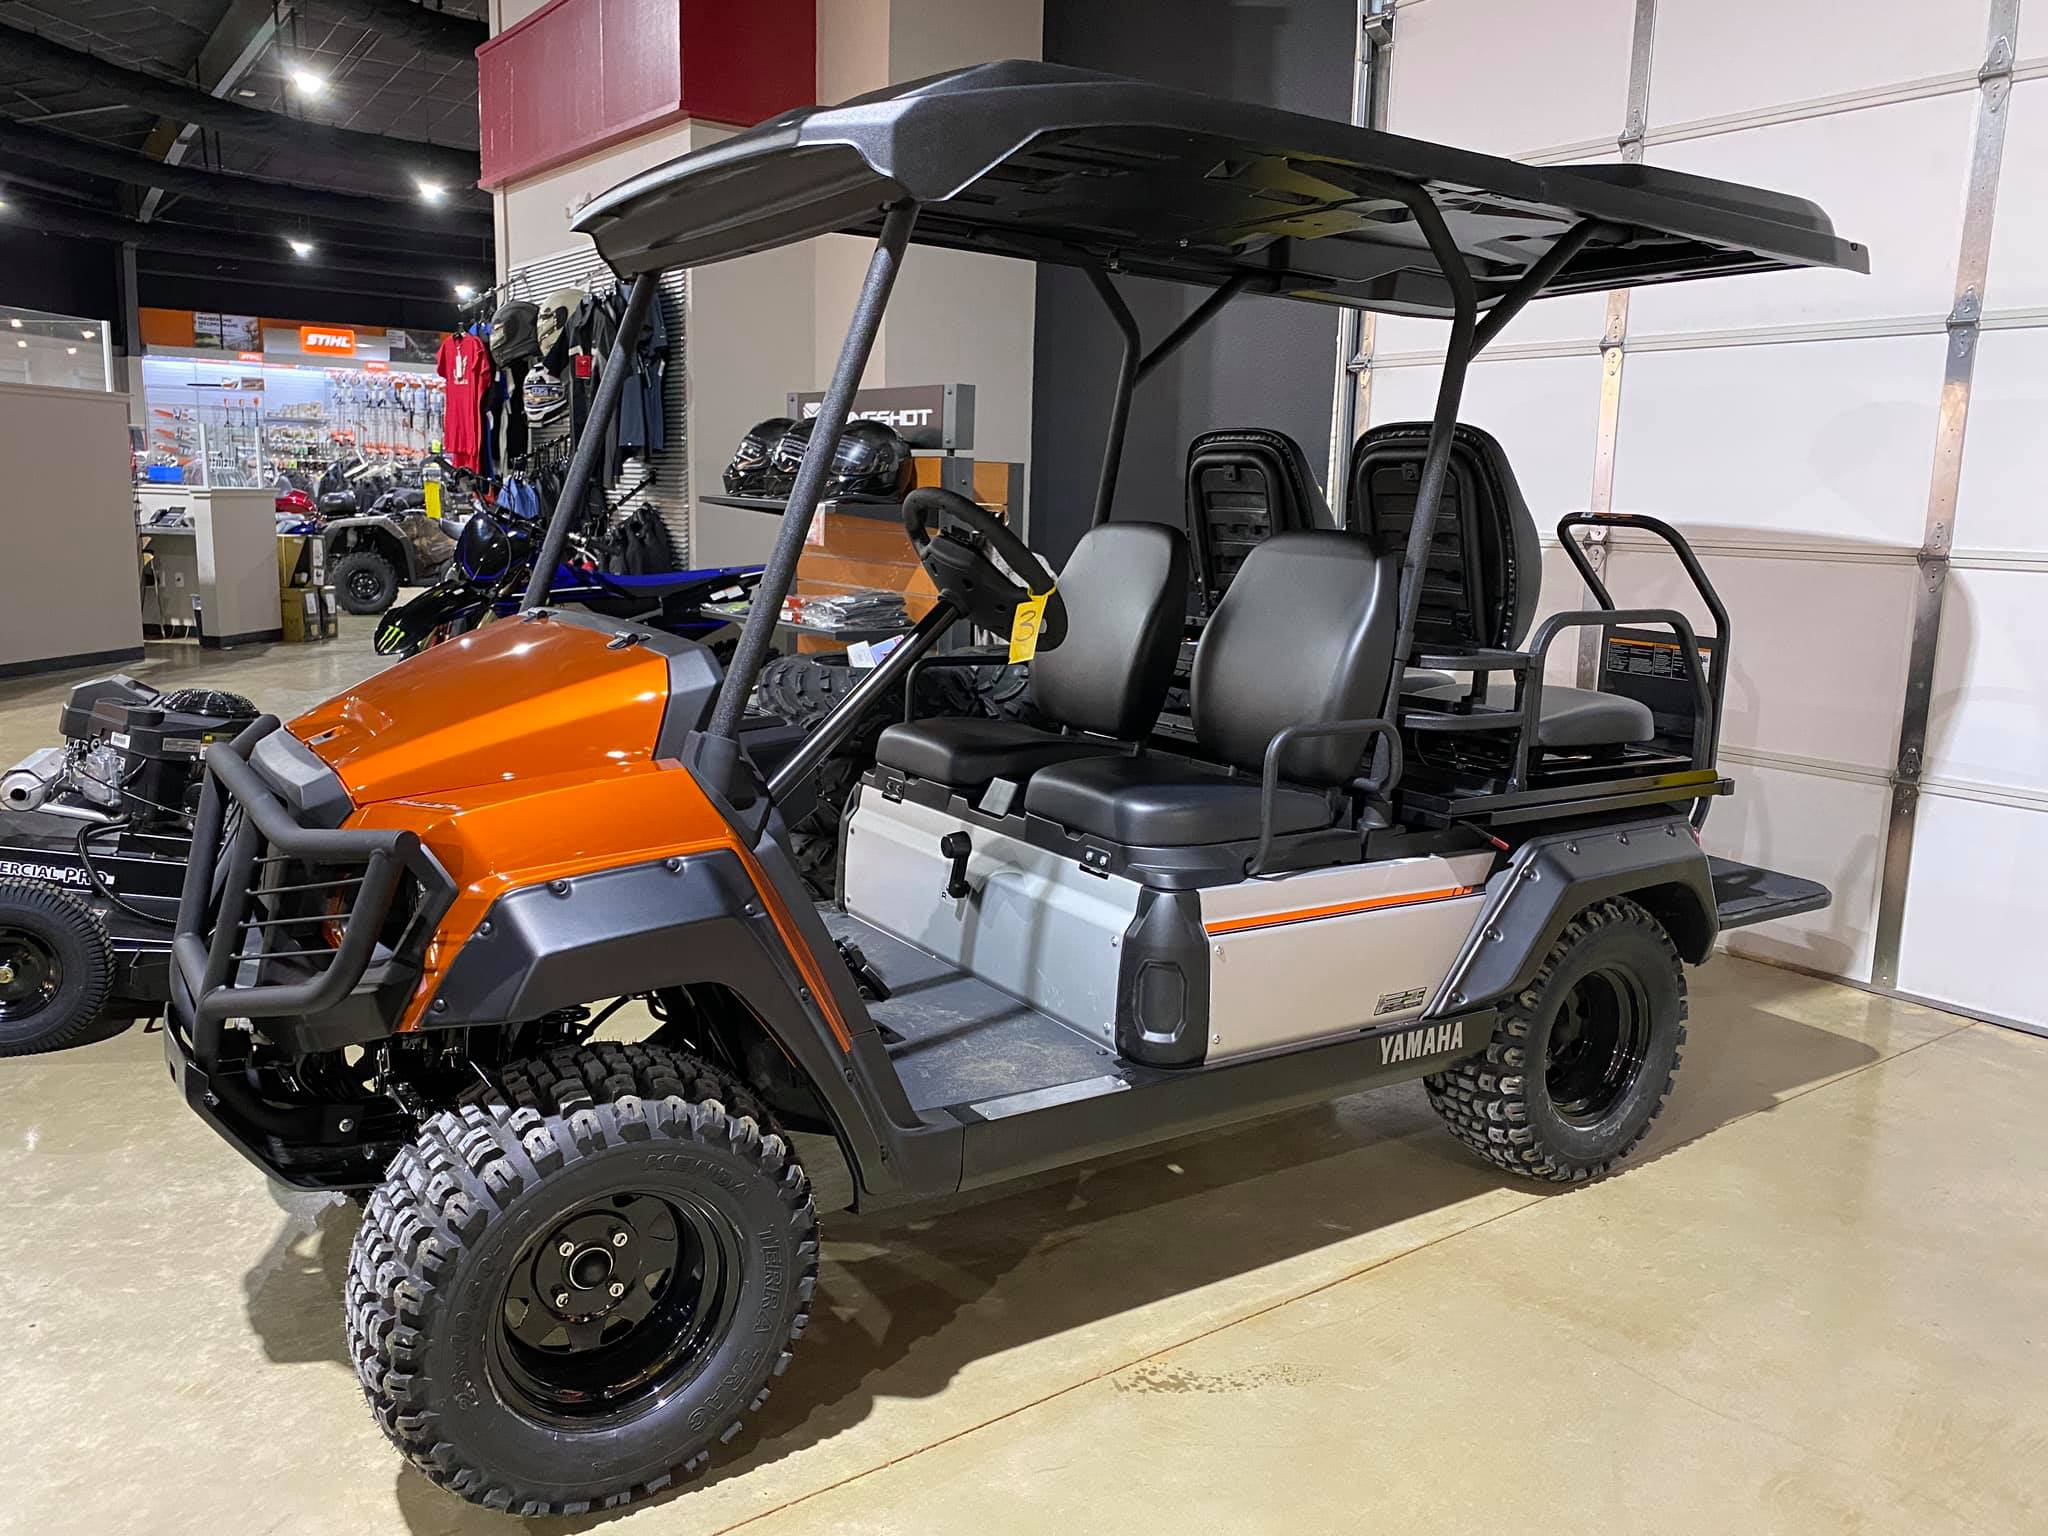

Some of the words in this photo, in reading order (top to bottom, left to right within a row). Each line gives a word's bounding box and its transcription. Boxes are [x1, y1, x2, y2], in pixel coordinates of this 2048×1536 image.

[240, 353, 262, 361] STIHL
[305, 333, 352, 348] STIHL
[1014, 609, 1037, 642] 3
[1380, 1021, 1463, 1065] YAMAHA
[754, 1223, 785, 1335] TERRA
[688, 1349, 763, 1431] TRAC
